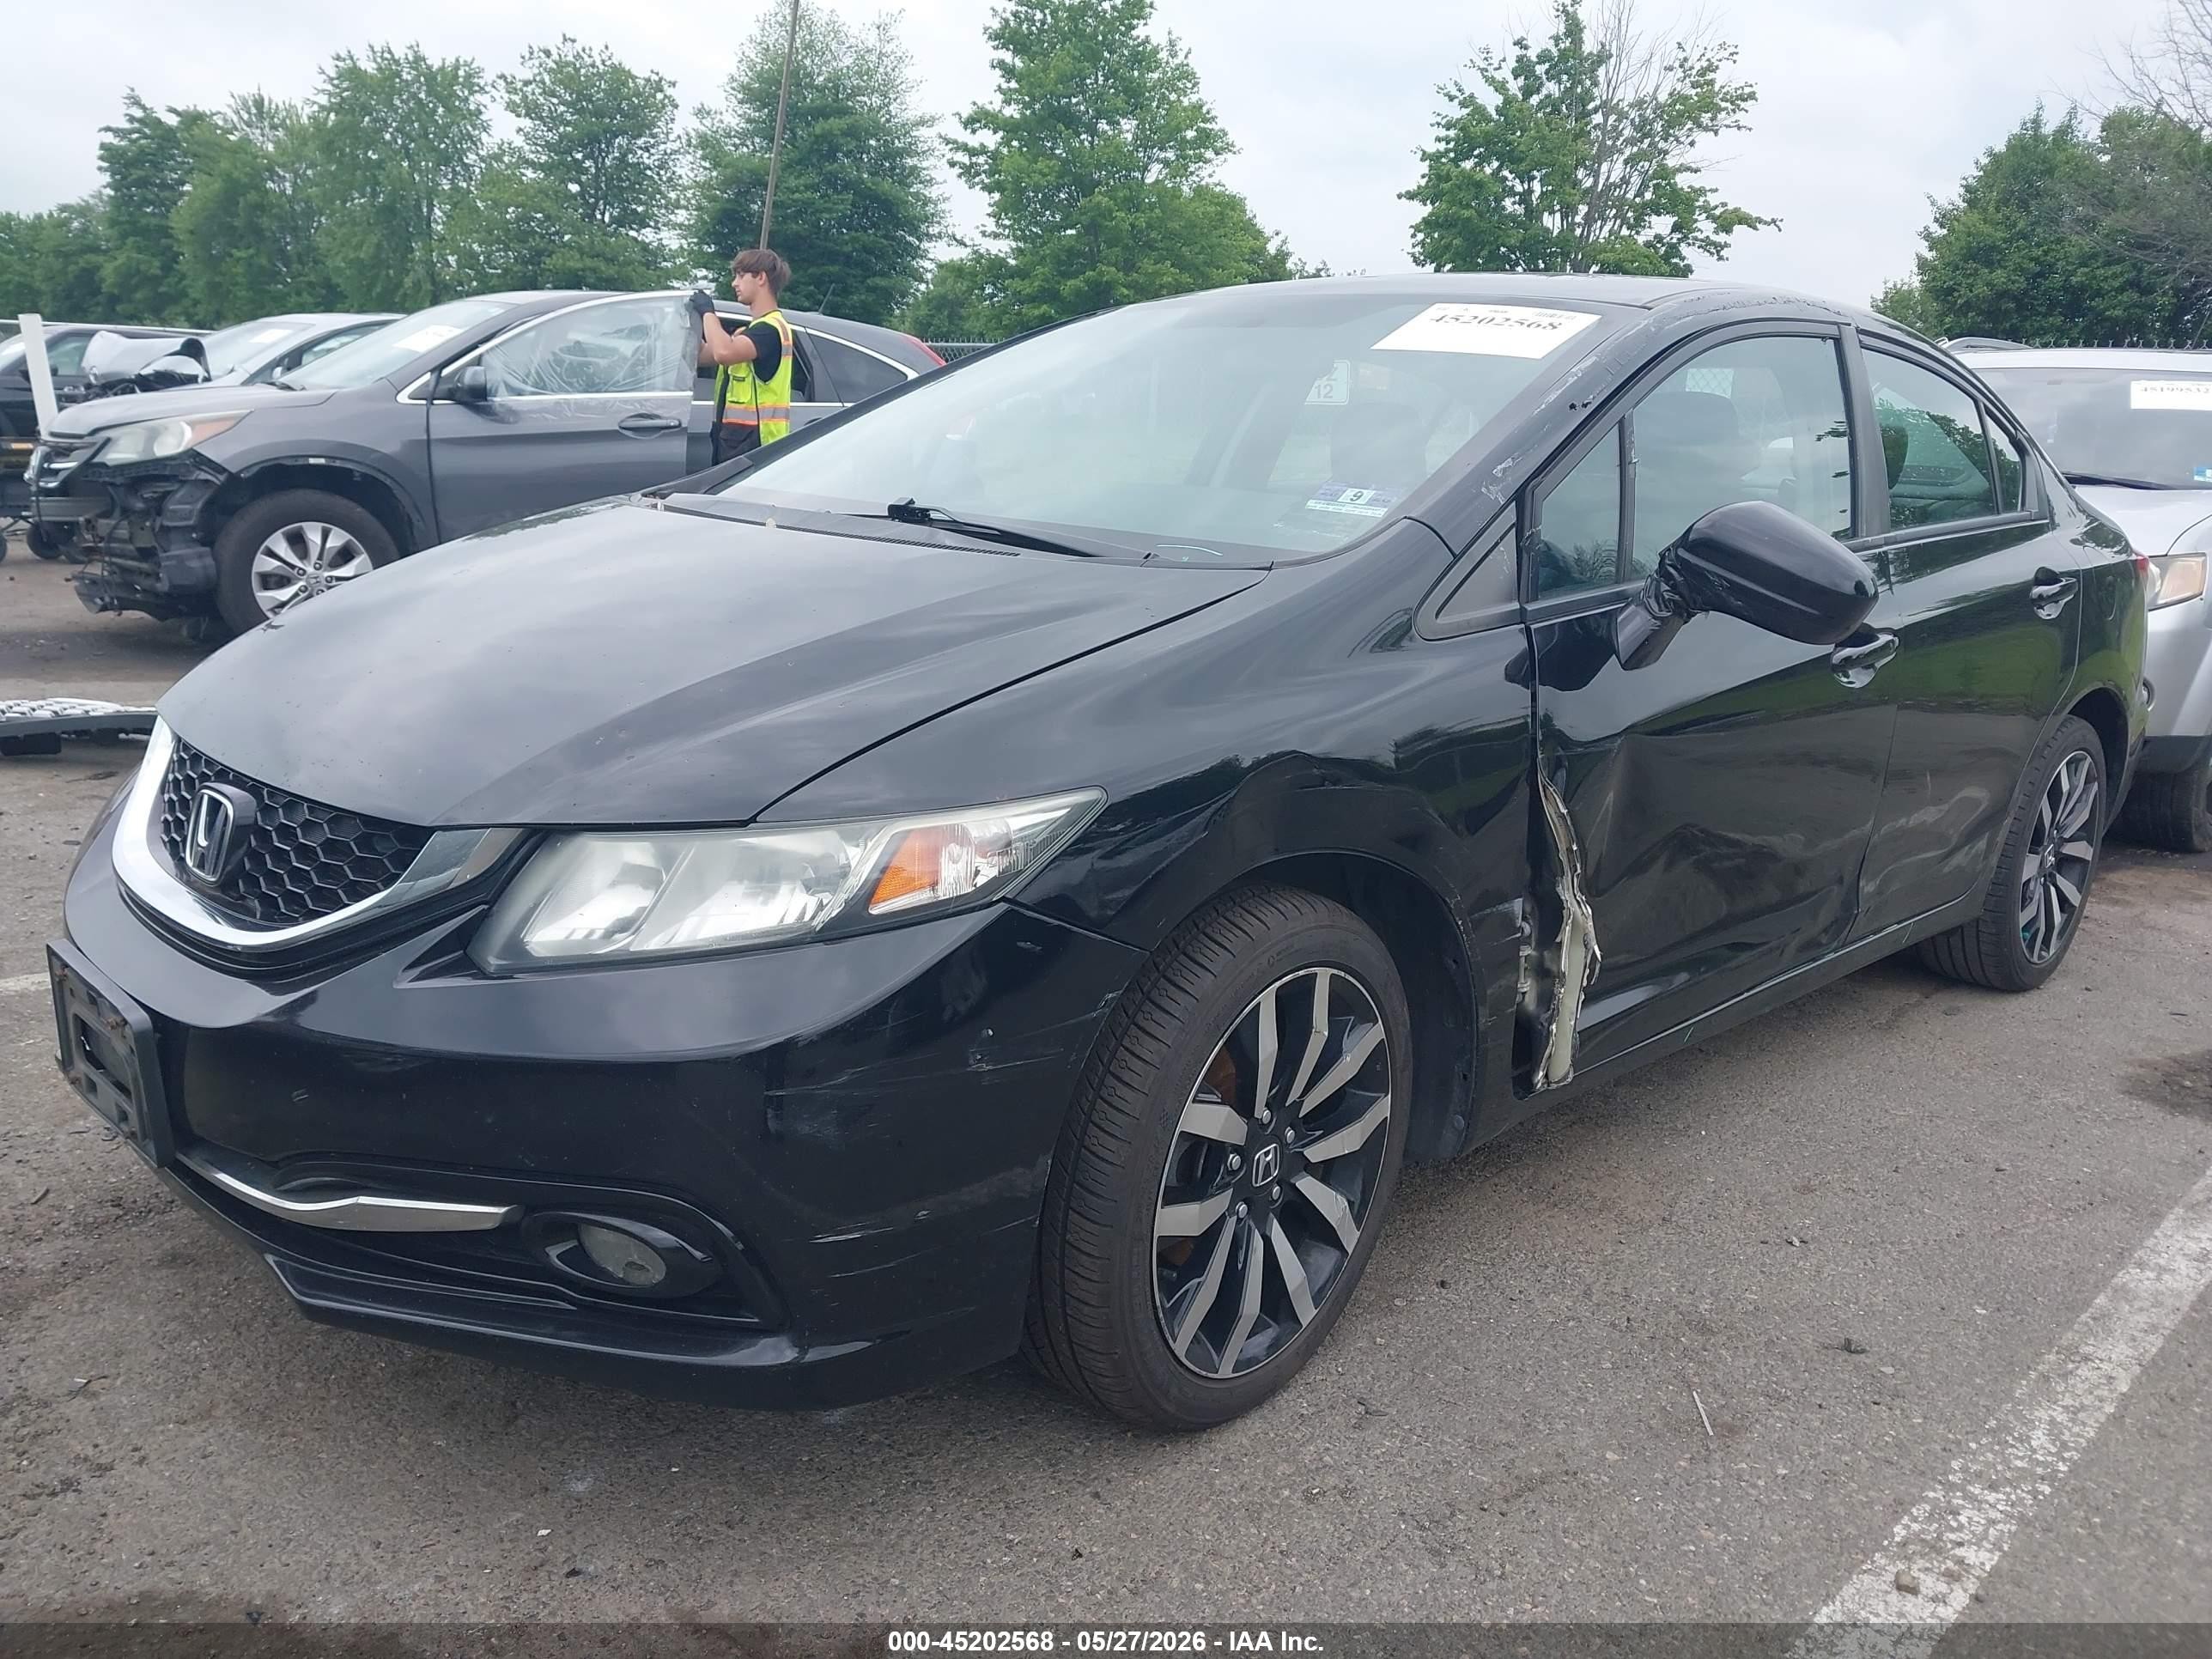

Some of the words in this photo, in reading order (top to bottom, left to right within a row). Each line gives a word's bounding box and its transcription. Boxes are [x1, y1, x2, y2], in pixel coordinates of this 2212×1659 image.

[1430, 314, 1563, 331] 45202568
[1315, 384, 1334, 399] 12
[1349, 490, 1364, 502] 9
